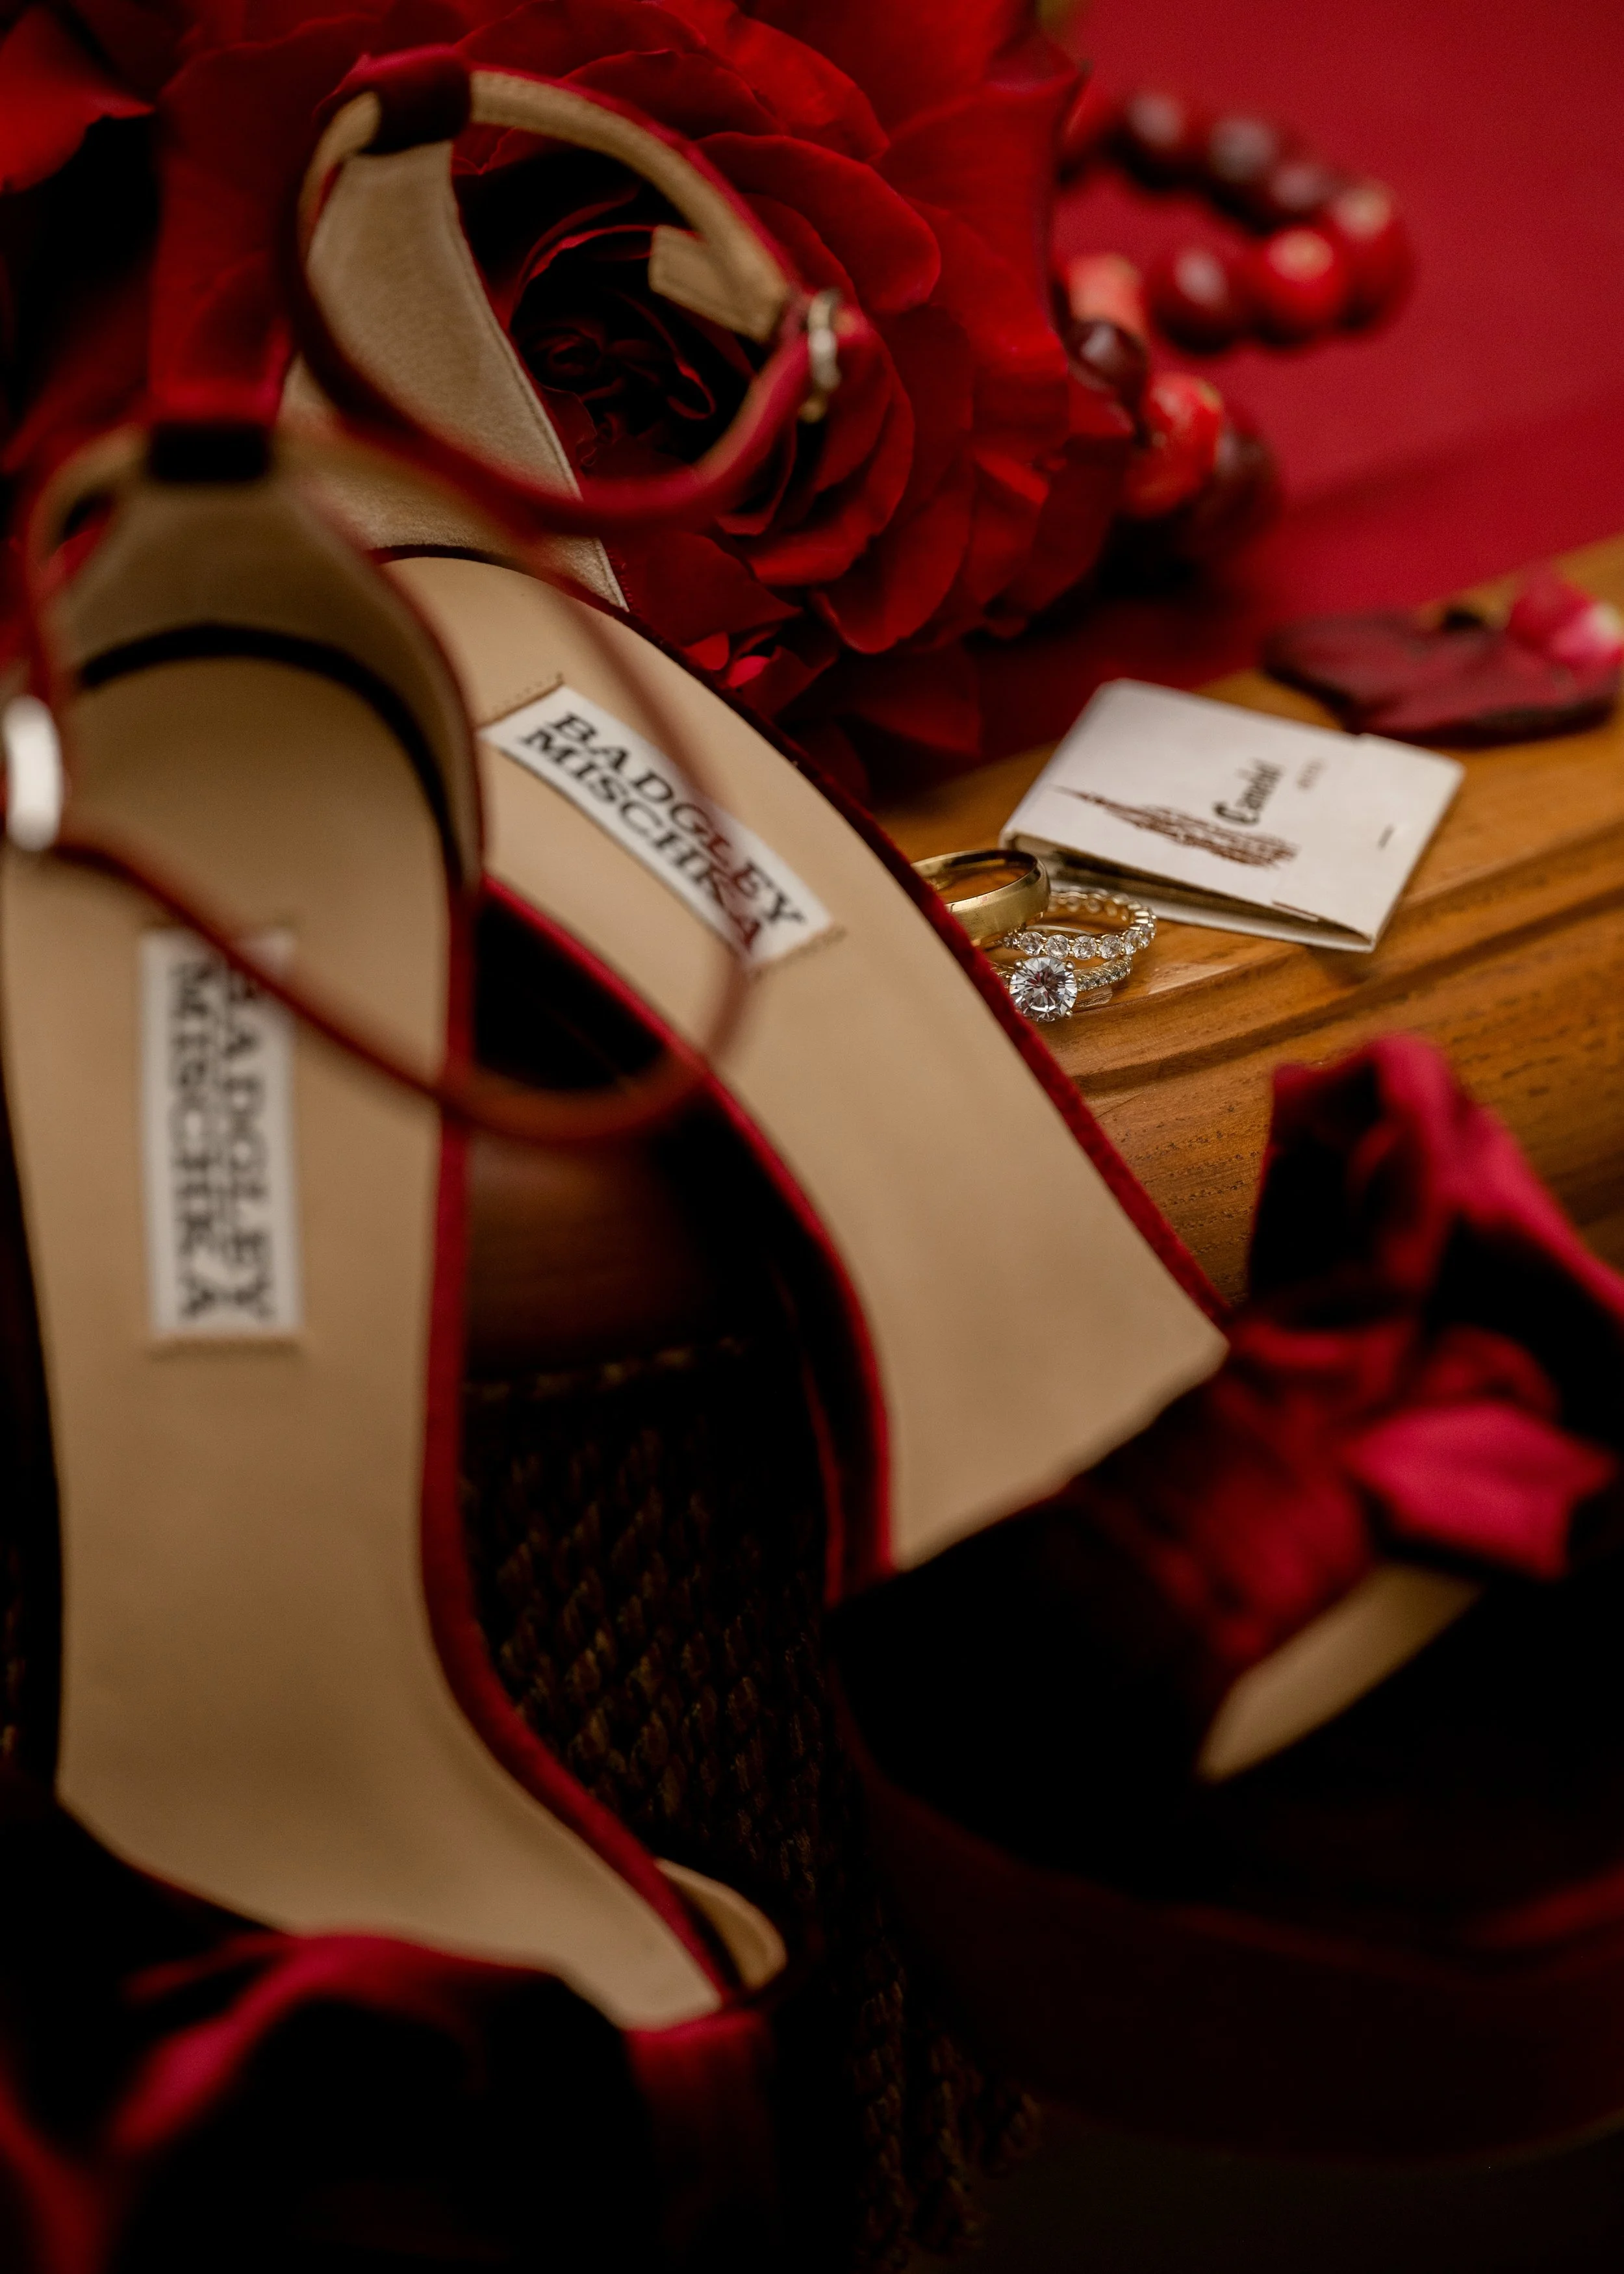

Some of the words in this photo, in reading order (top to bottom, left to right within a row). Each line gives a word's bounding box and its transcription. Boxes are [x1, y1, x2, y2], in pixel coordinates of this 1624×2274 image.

[518, 727, 763, 954] MISCHKA
[550, 711, 807, 926] BADGLEY
[169, 962, 218, 1322] MISCHKA
